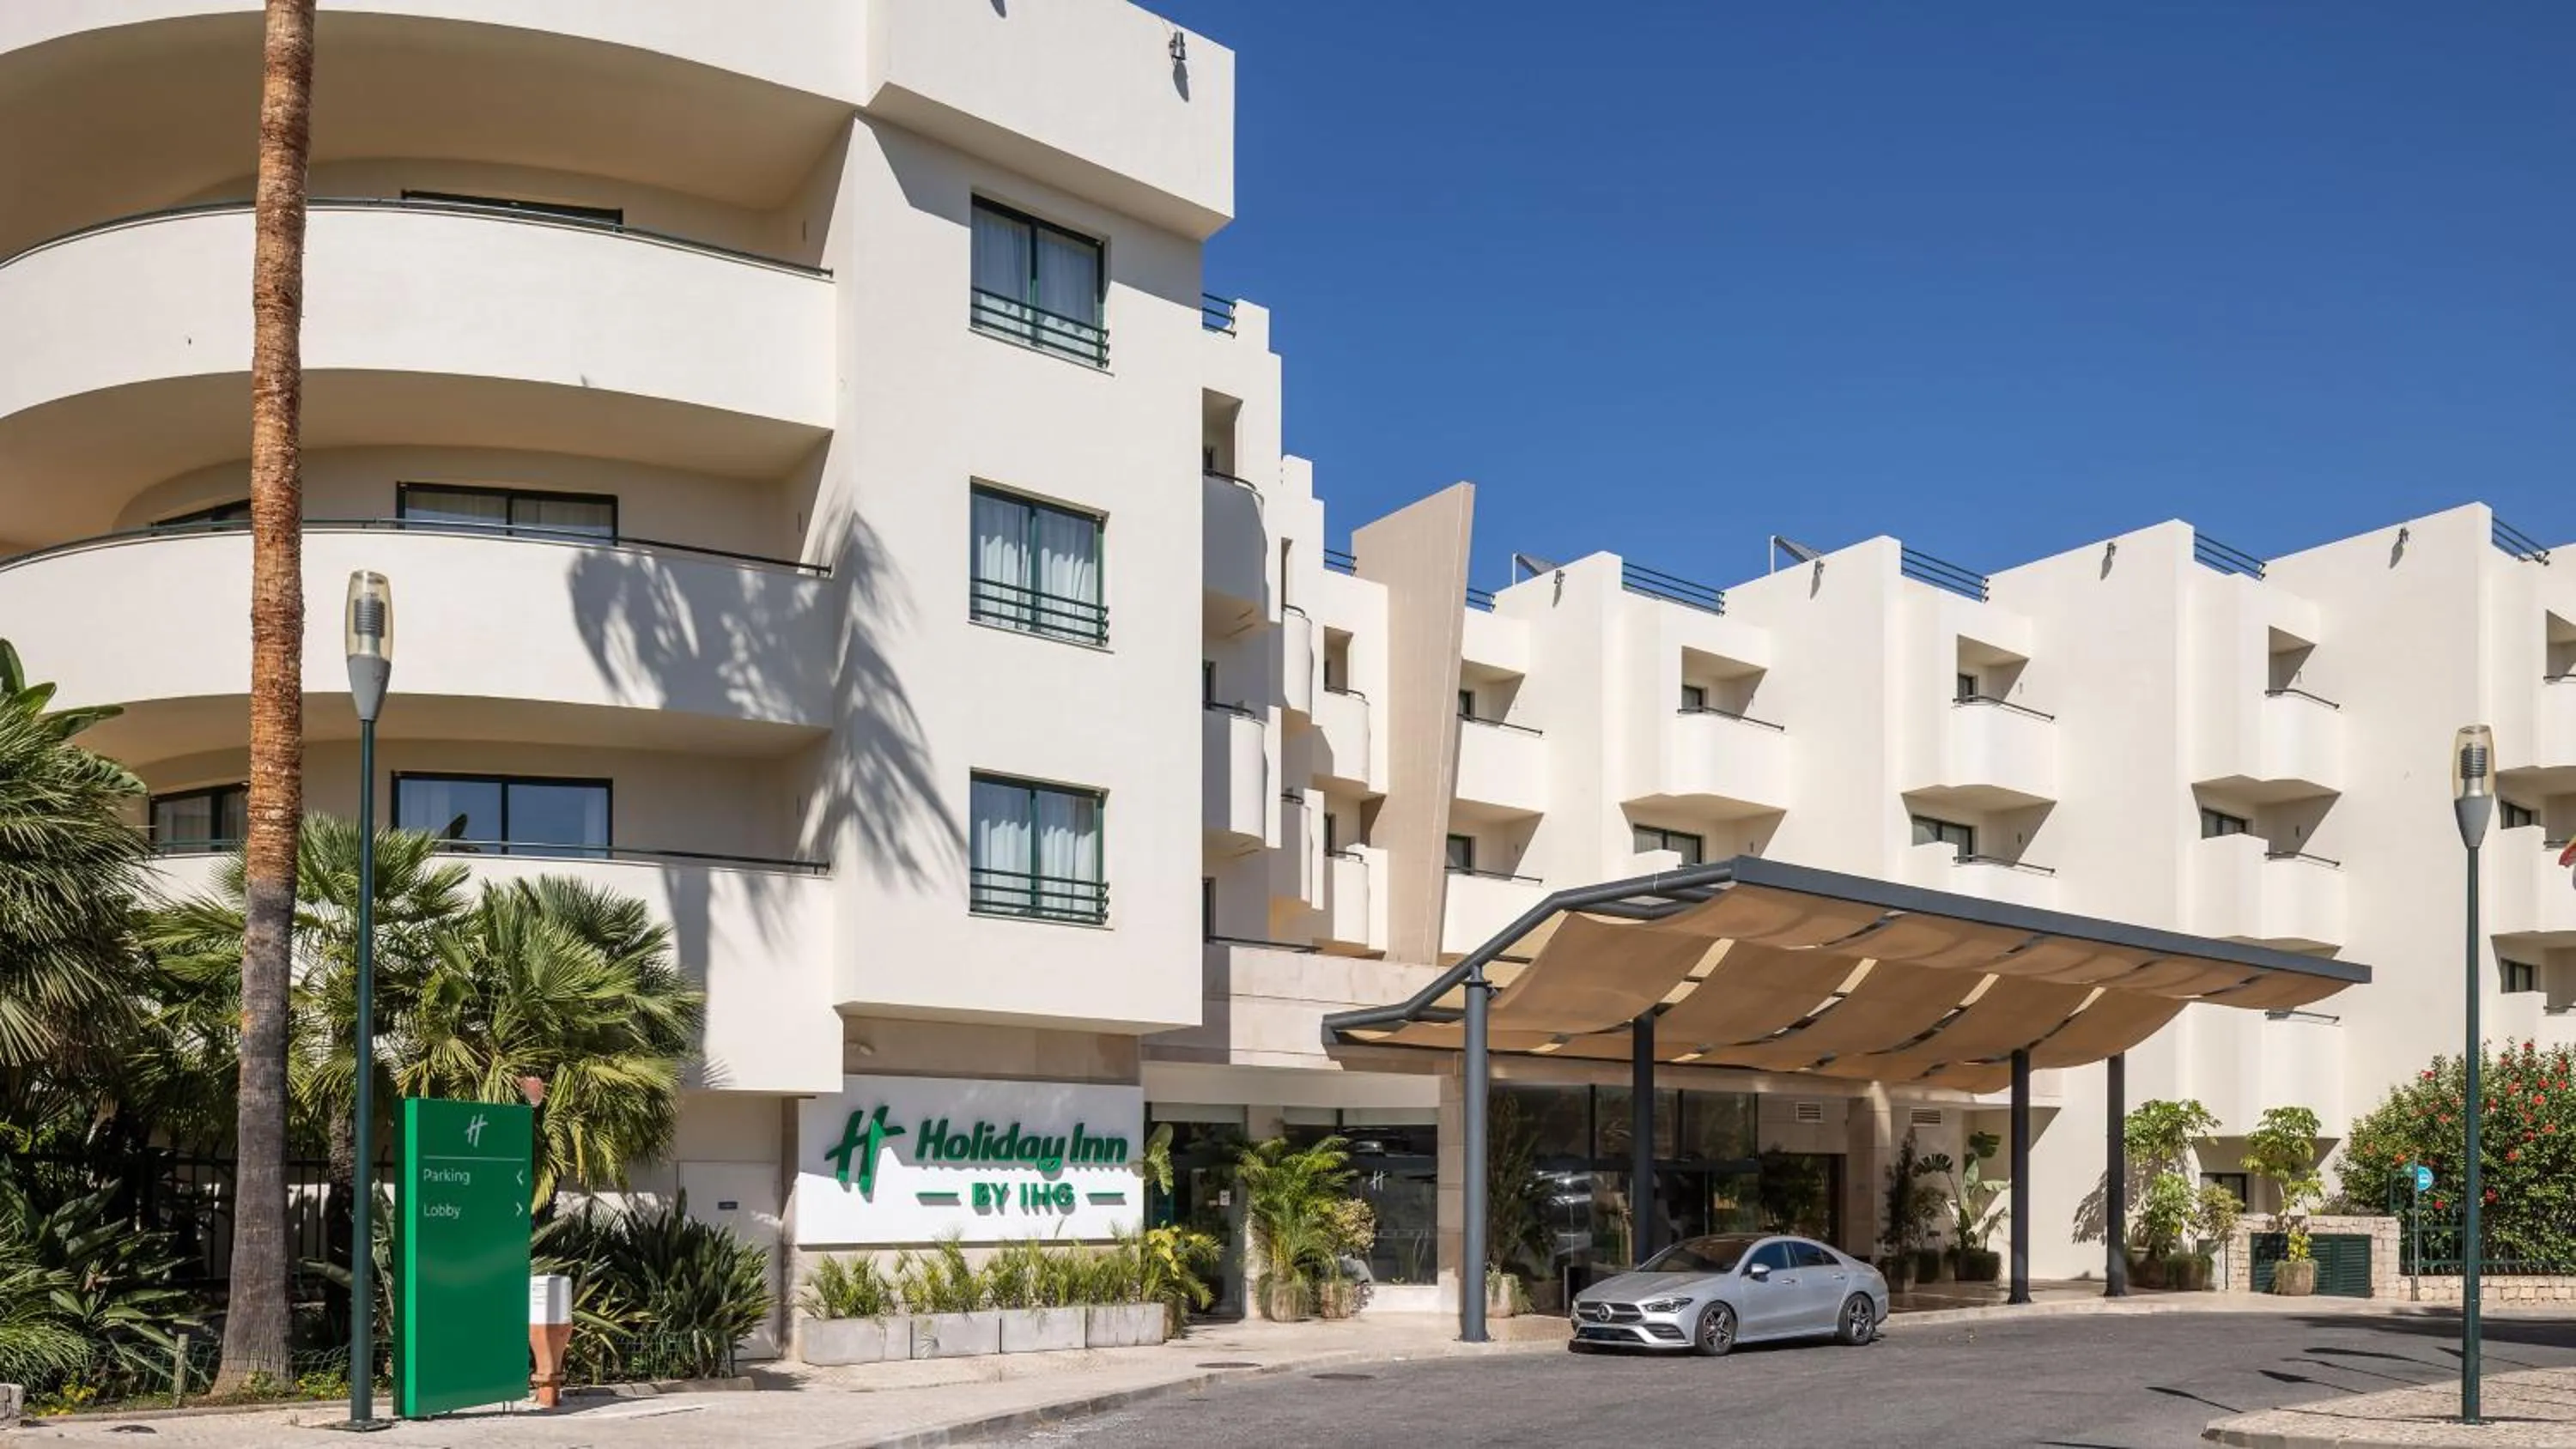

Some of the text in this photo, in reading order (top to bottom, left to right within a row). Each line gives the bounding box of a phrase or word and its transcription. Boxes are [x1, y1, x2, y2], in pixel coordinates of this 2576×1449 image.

[914, 1119, 1128, 1172] Holiday Inn
[423, 1168, 471, 1185] Parking
[972, 1182, 1074, 1207] BY IHG
[423, 1203, 461, 1220] Lobby
